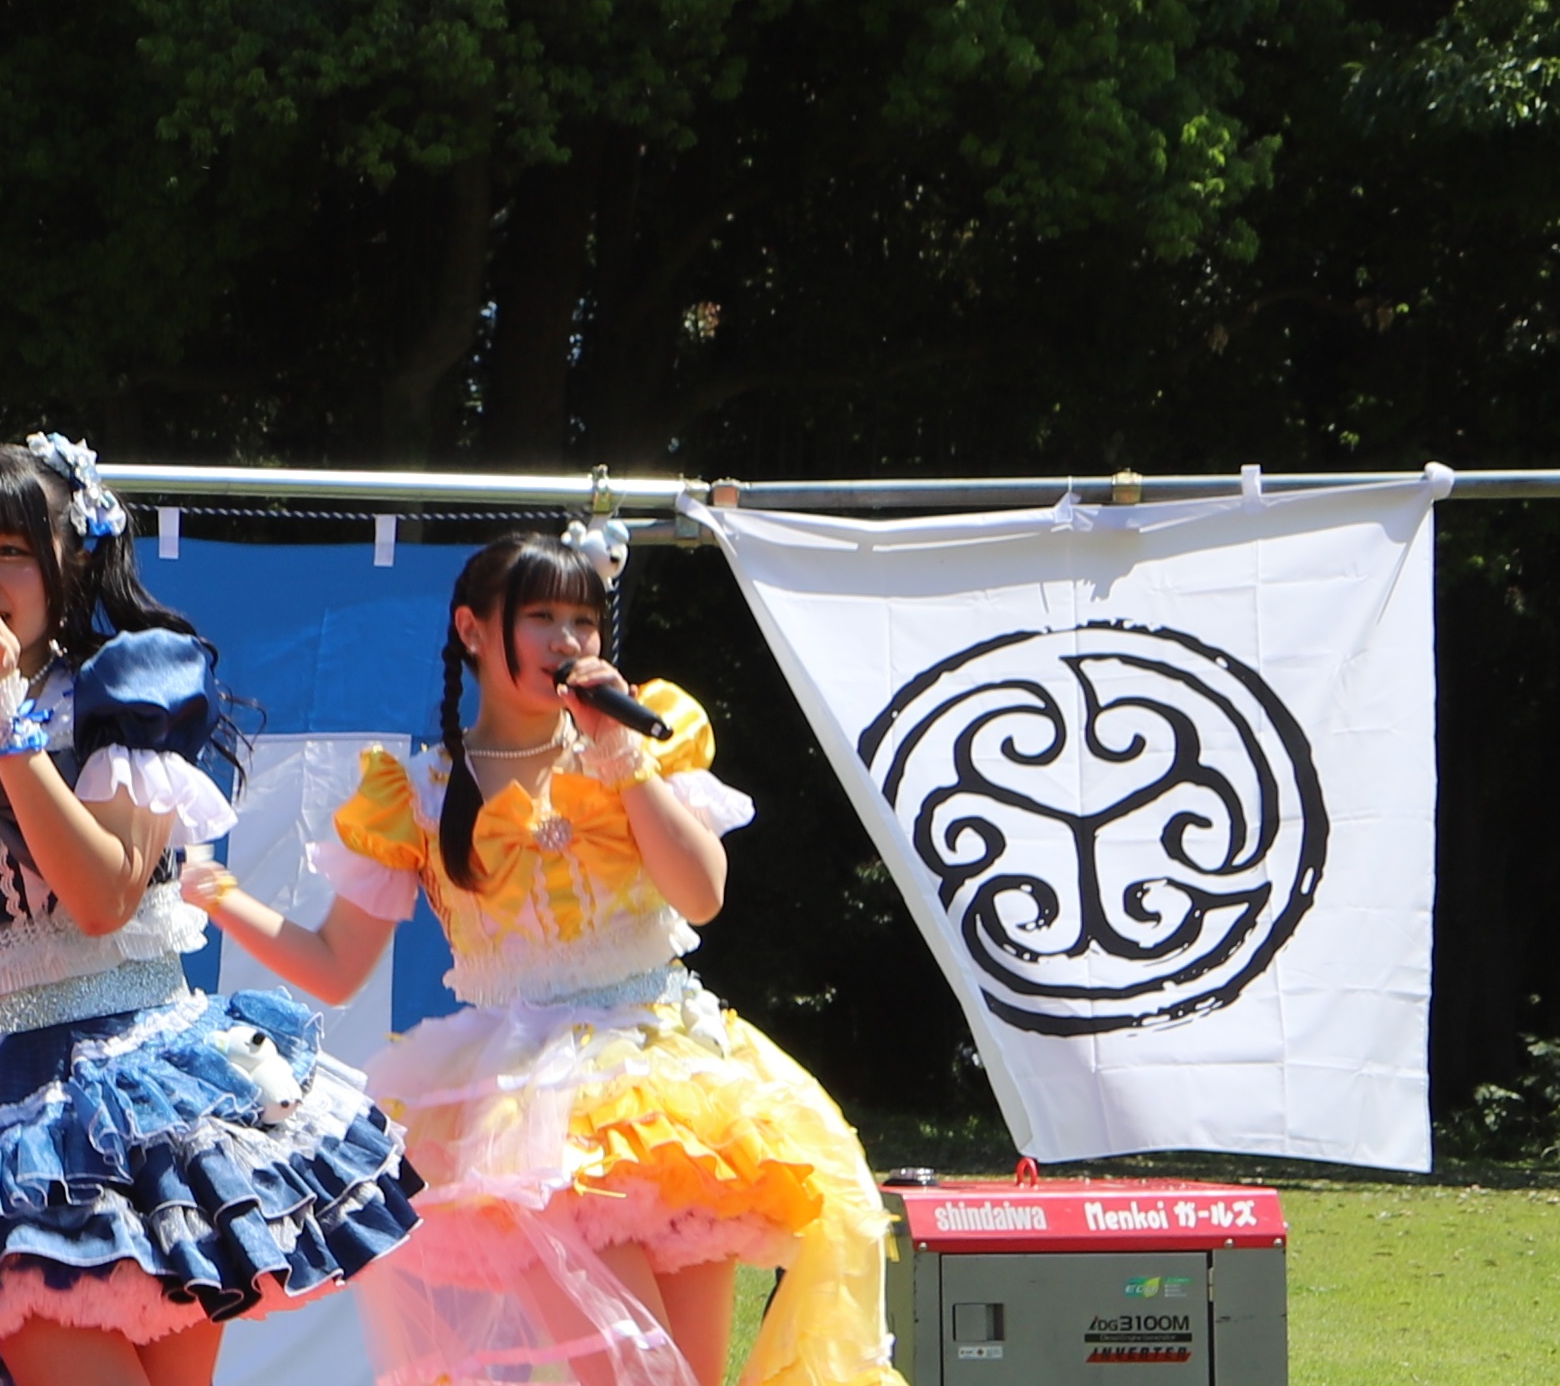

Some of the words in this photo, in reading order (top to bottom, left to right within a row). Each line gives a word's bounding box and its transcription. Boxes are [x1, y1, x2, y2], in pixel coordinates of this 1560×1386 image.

[934, 1201, 1047, 1231] shindaiwa
[1084, 1201, 1168, 1231] Menkoi
[1174, 1200, 1257, 1228] ガールズ
